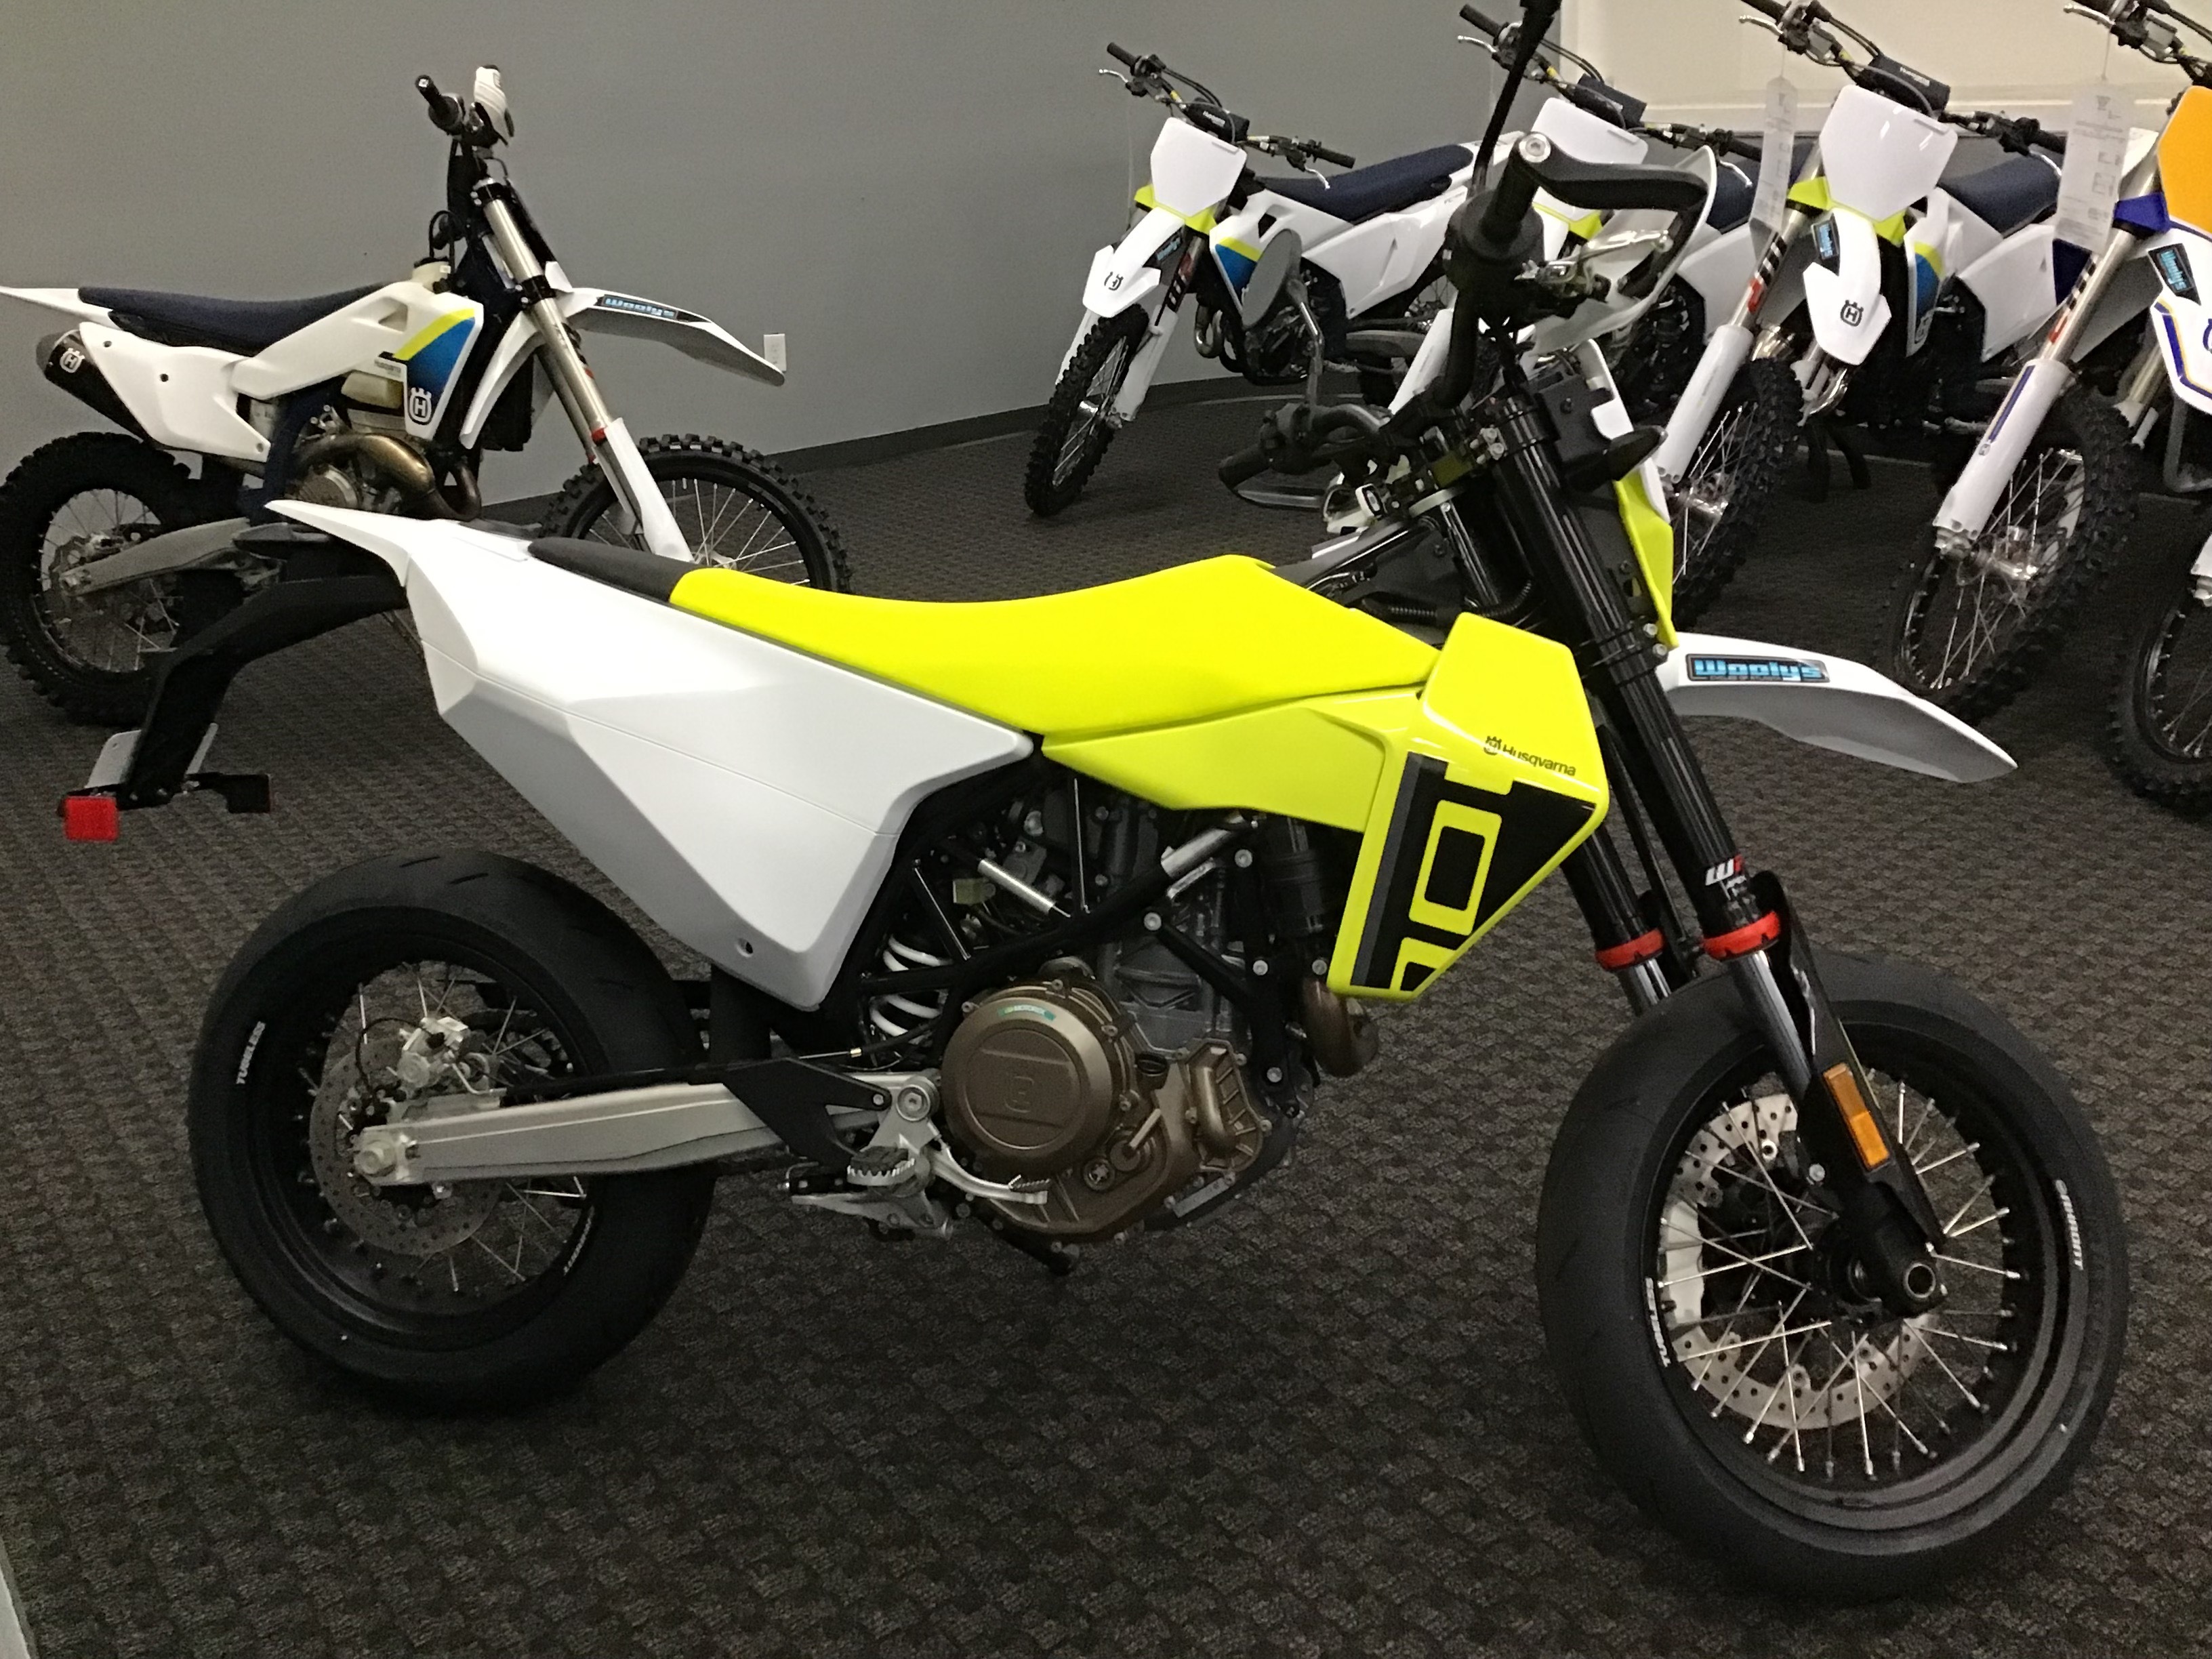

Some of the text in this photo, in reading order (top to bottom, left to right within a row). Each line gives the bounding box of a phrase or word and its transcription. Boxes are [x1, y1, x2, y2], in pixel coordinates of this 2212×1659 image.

[1694, 659, 1822, 682] Woolys
[1502, 743, 1576, 777] Husqvarna
[1645, 1277, 1671, 1368] TUBELESS
